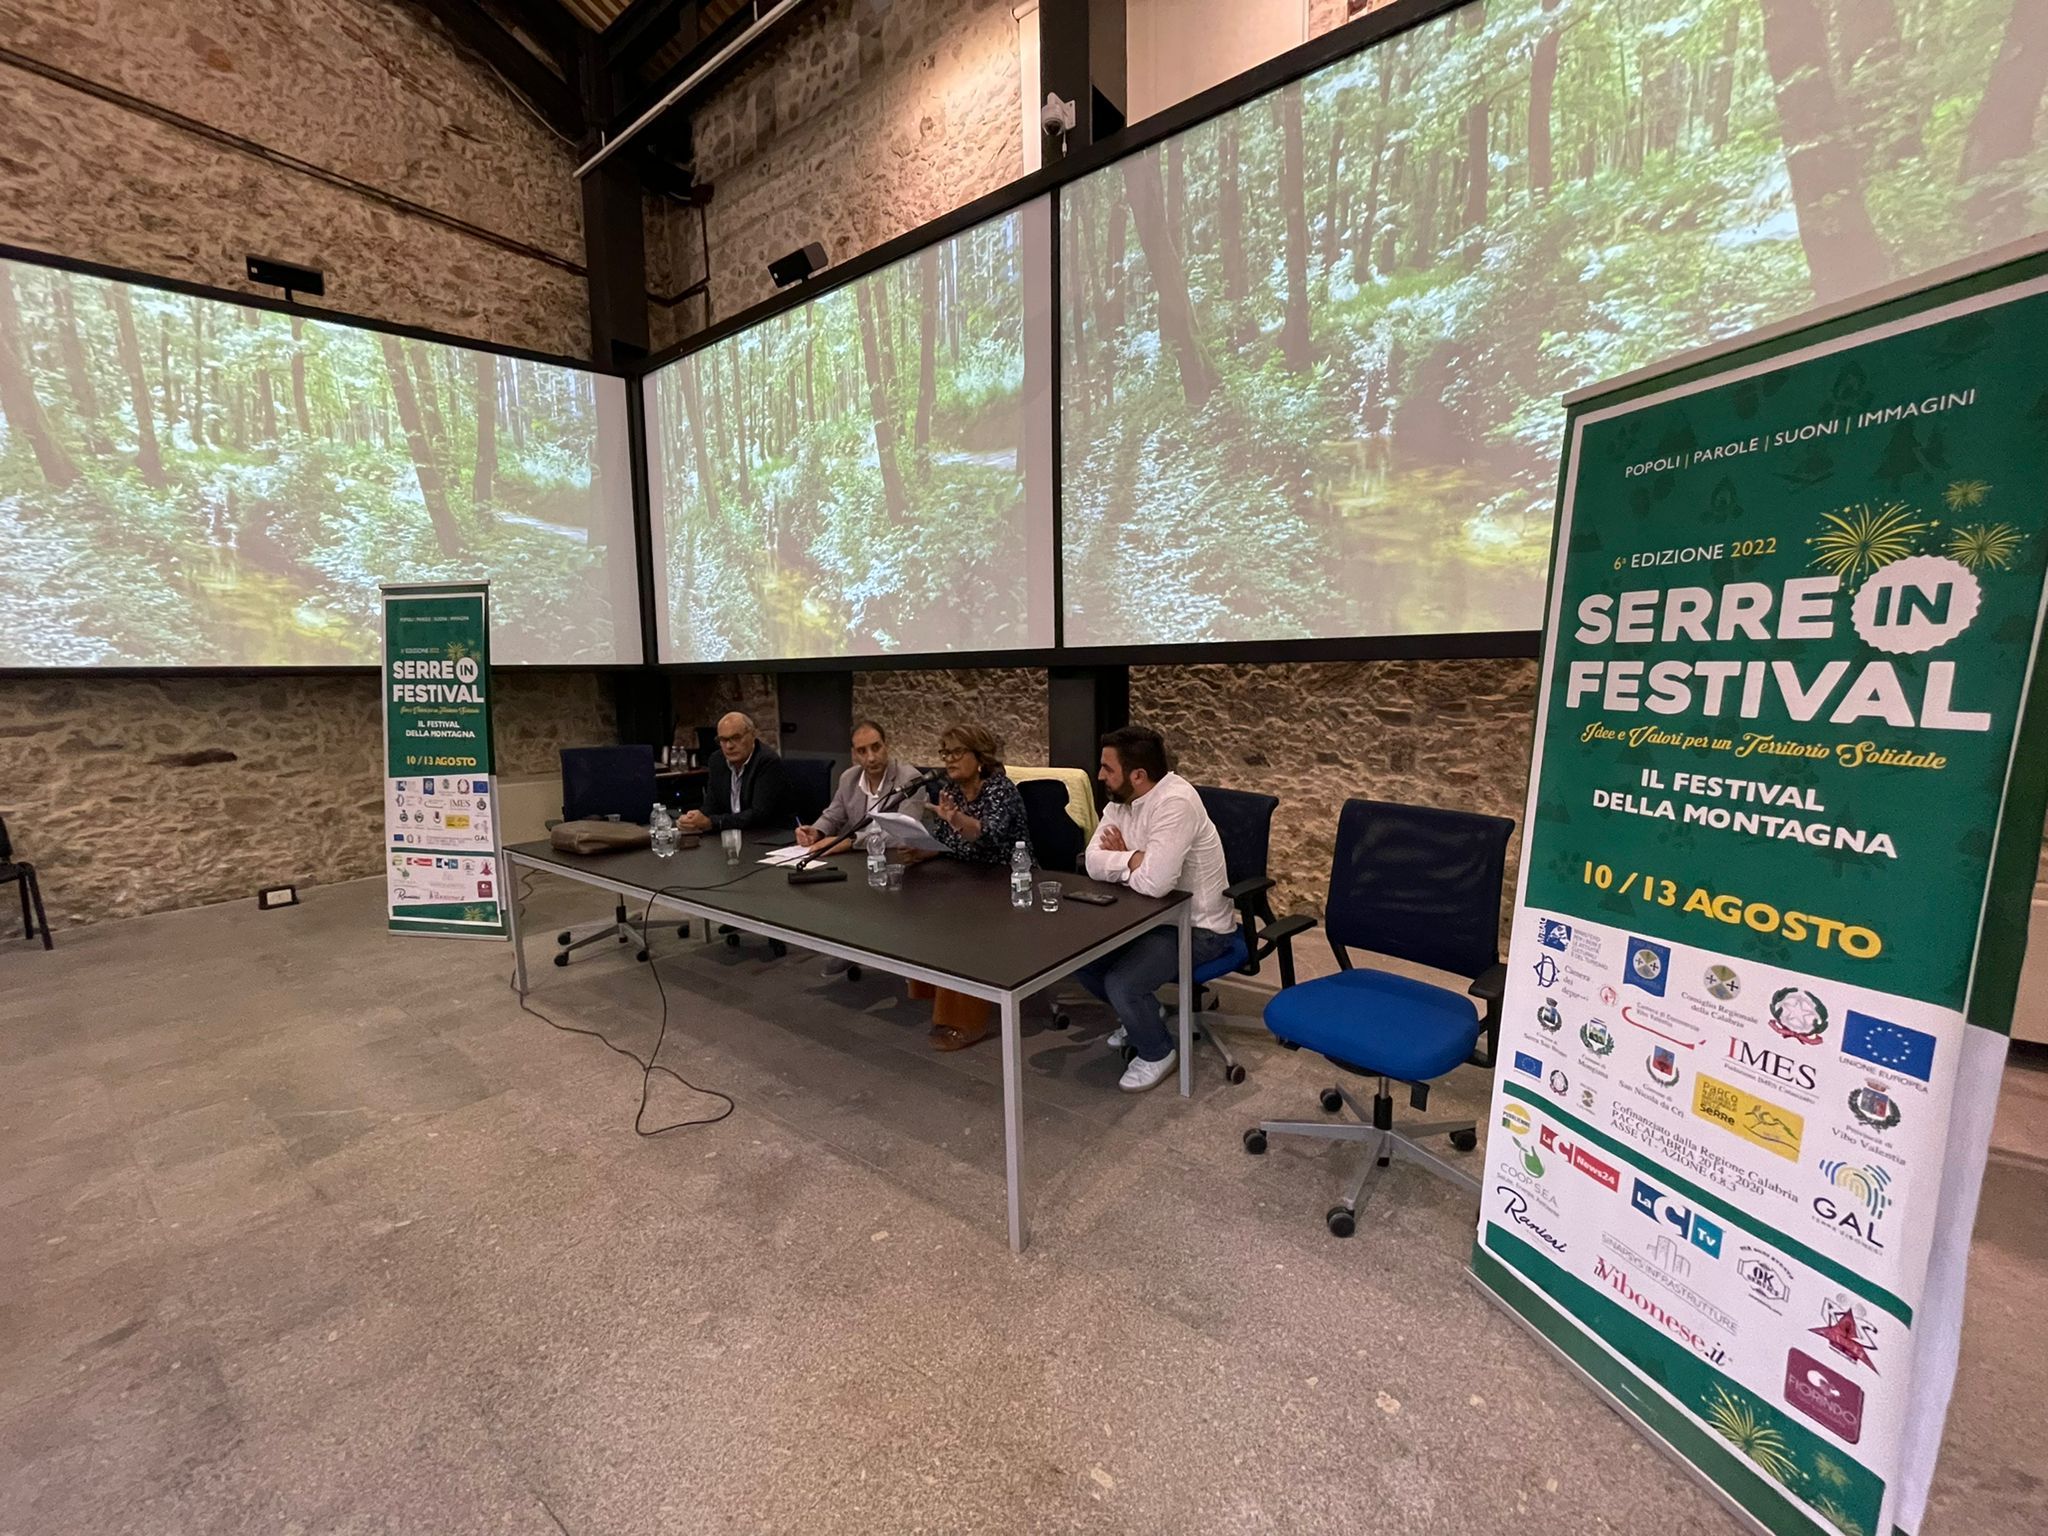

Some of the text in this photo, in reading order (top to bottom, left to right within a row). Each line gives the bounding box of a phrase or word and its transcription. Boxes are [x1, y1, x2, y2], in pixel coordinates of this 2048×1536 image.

[1625, 456, 1680, 478] POPOLI
[1694, 438, 1759, 463] PAROLE
[1774, 419, 1839, 446] SUONI
[1857, 388, 1976, 428] IMMAGINI
[1630, 544, 1724, 568] EDIZIONE
[1730, 537, 1777, 558] 2022
[1573, 575, 1953, 645] SERRE IN
[393, 661, 473, 679] SERRE IN
[393, 684, 484, 703] FESTIVAL
[1566, 660, 1991, 731] FESTIVAL
[405, 729, 476, 738] DELLA MONTAGNA
[418, 720, 425, 728] IL
[1581, 721, 1947, 770] Idee e Valori per un Territorio Solidale
[406, 756, 416, 765] 10
[424, 756, 434, 765] 13
[435, 756, 477, 766] AGOSTO
[1641, 769, 1825, 812] IL FESTIVAL
[1593, 789, 1898, 859] DELLA MONTAGNA
[1583, 861, 1613, 889] 10
[1643, 876, 1677, 907] 13
[1683, 888, 1882, 960] AGOSTO
[1728, 1036, 1817, 1090] IMES
[1839, 1056, 1928, 1094] UNIONE EUROPEA
[1610, 1119, 1638, 1139] ASSE
[1661, 1147, 1707, 1178] AZIONE
[1611, 1109, 1635, 1128] PAC
[1635, 1122, 1695, 1160] CALABRIA
[1699, 1156, 1725, 1176] 2014
[1733, 1175, 1765, 1197] 2020
[1613, 1101, 1671, 1137] Cofinanziato
[1673, 1133, 1698, 1150] dalla
[1700, 1146, 1745, 1173] Regione
[1748, 1171, 1799, 1204] Calabria
[1832, 1127, 1906, 1165] Vibo Valentia
[1497, 1186, 1567, 1253] Ranieri
[1813, 1197, 1884, 1248] GAL
[1753, 1266, 1774, 1288] OK
